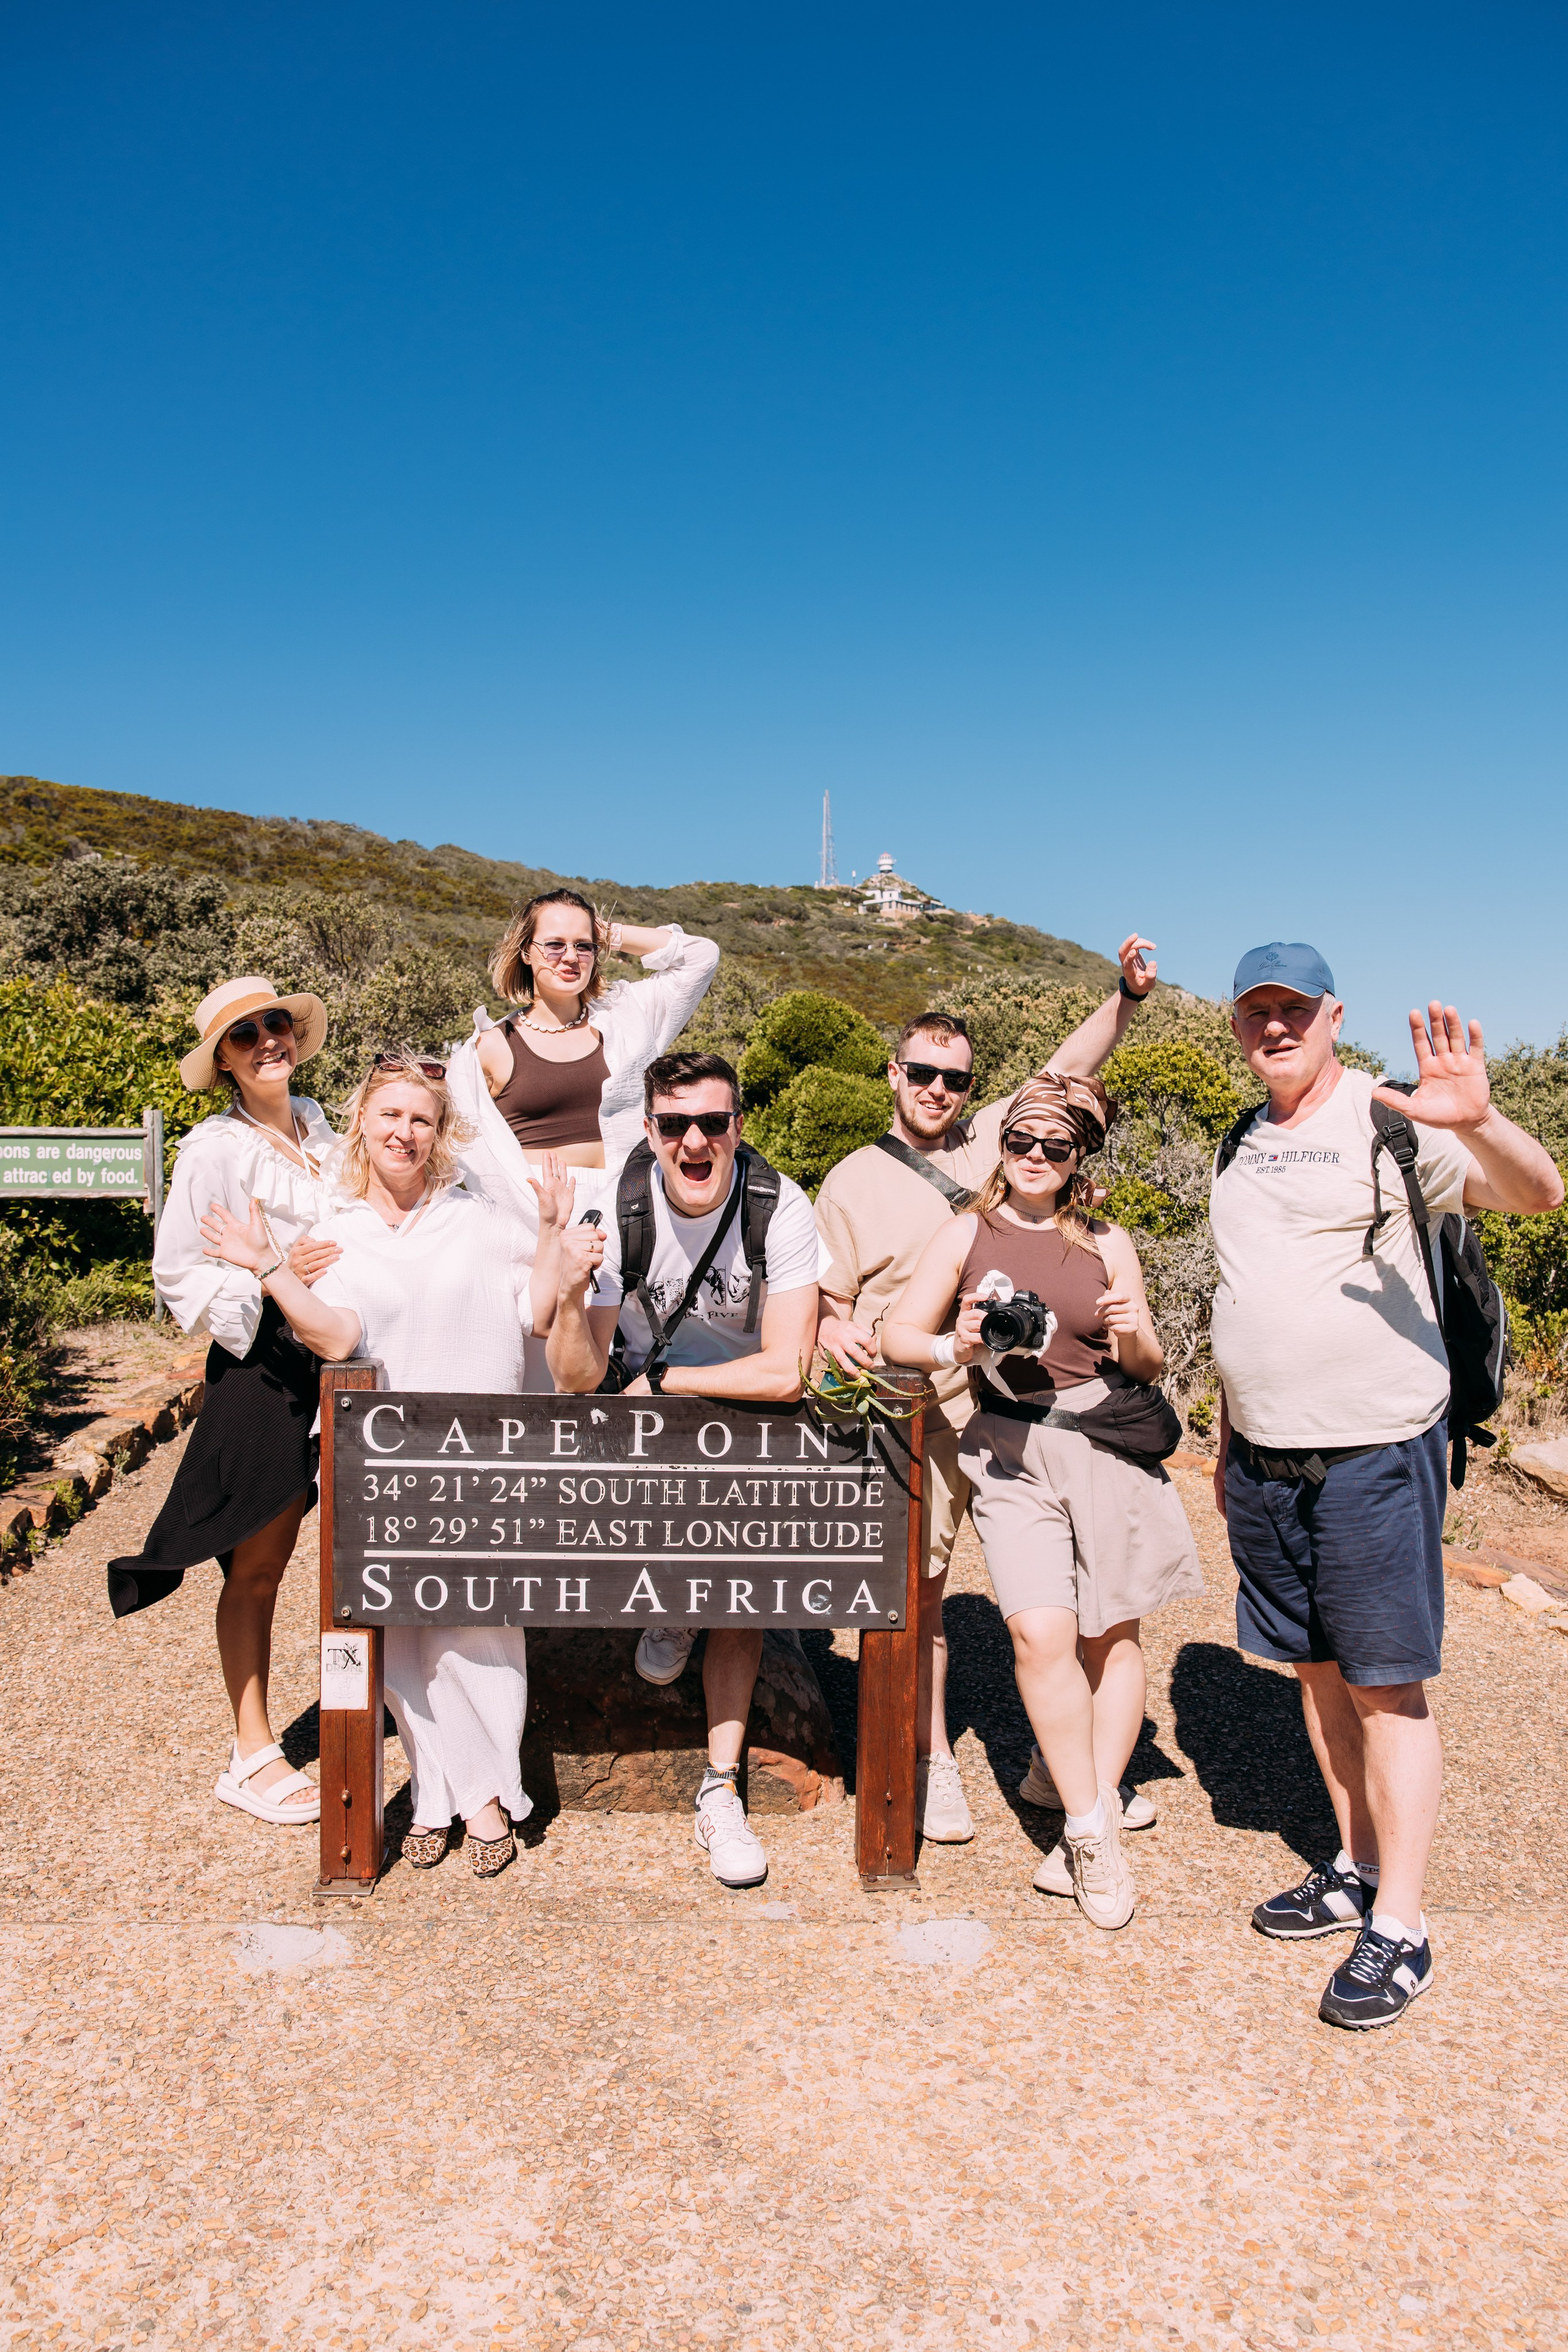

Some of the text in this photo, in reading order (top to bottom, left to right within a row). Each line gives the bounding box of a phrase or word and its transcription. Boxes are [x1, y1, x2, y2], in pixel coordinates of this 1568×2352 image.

[0, 1143, 142, 1164] ons are dangerous
[1237, 1151, 1340, 1166] TOMMY HILFIGER
[77, 1167, 95, 1187] by
[101, 1167, 138, 1184] food.
[707, 1311, 738, 1320] FIVE
[363, 1404, 886, 1458] CAPE POINT
[363, 1474, 417, 1501] 34°
[559, 1477, 687, 1505] SOUTH
[698, 1479, 884, 1507] LATITUDE
[366, 1516, 417, 1543] 18°
[556, 1520, 652, 1547] EAST
[662, 1521, 884, 1548] LONGITUDE
[362, 1564, 881, 1615] SOUTH AFRICA
